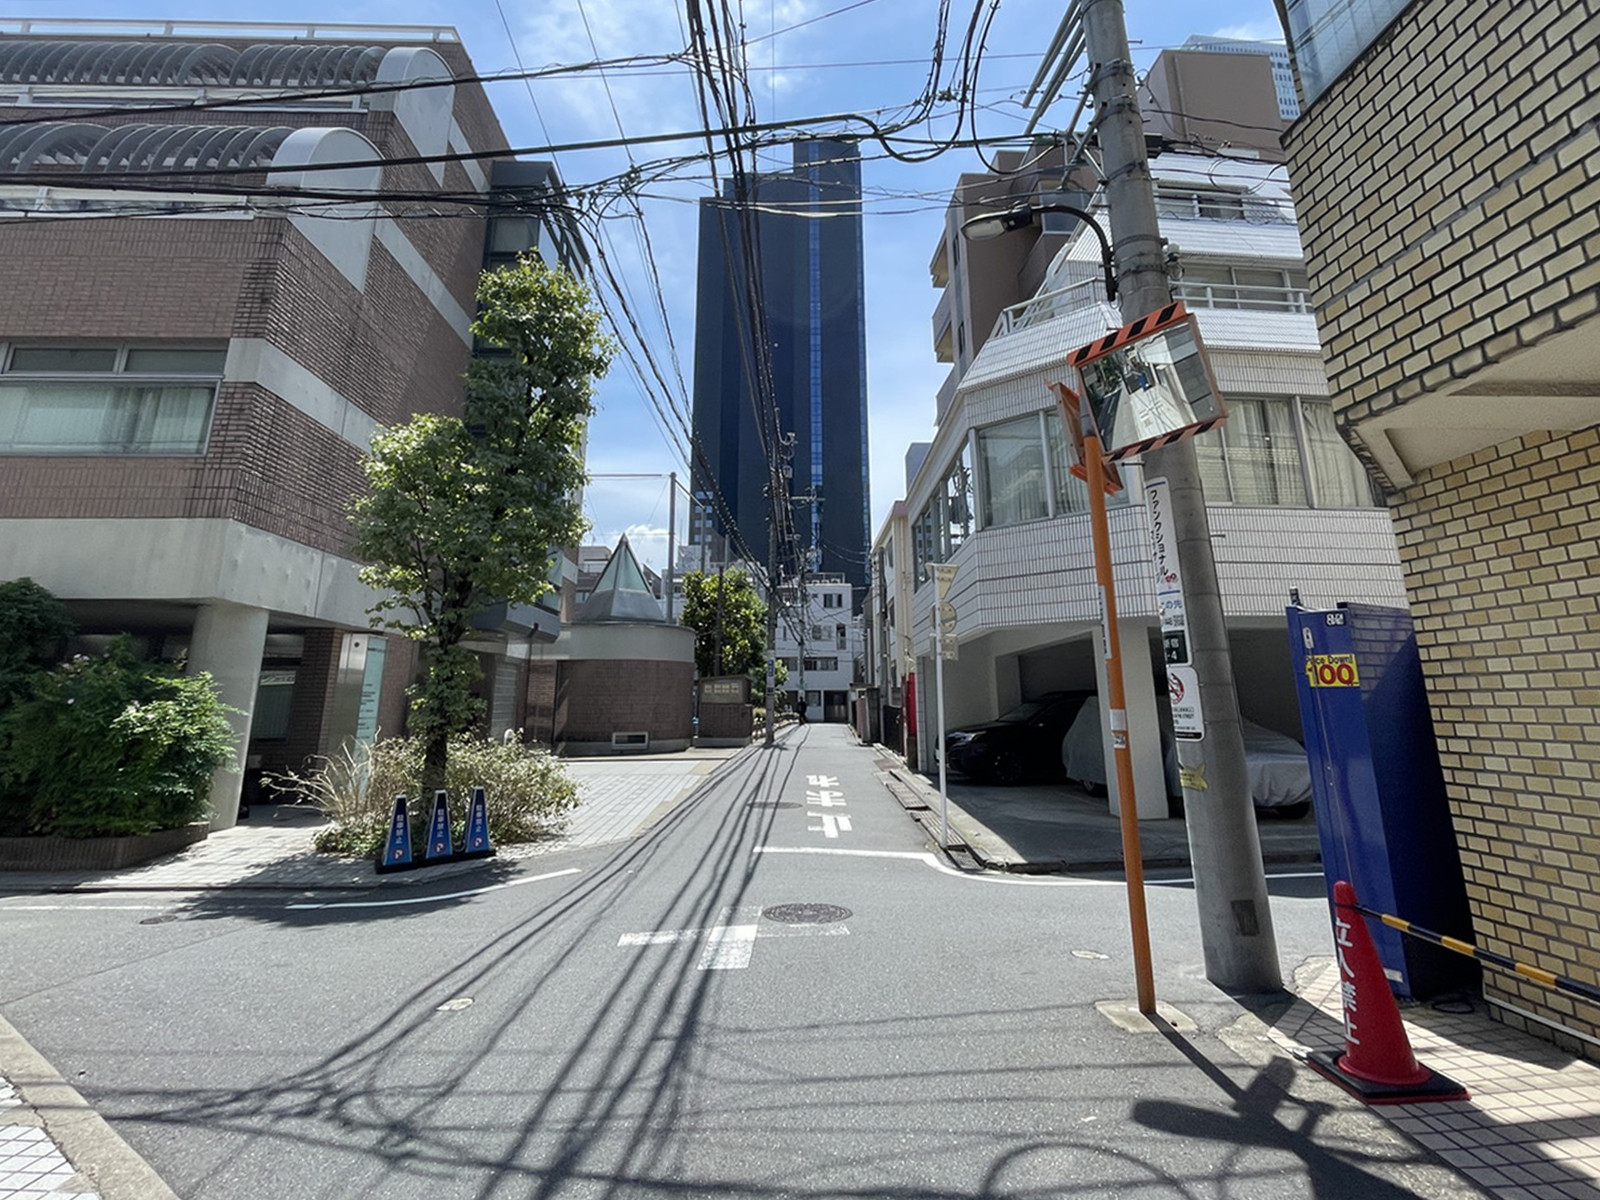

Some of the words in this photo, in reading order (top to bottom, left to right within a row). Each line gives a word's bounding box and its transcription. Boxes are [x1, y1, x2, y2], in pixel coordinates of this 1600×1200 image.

[1150, 489, 1168, 576] ファンクショナル
[1307, 663, 1355, 685] 100
